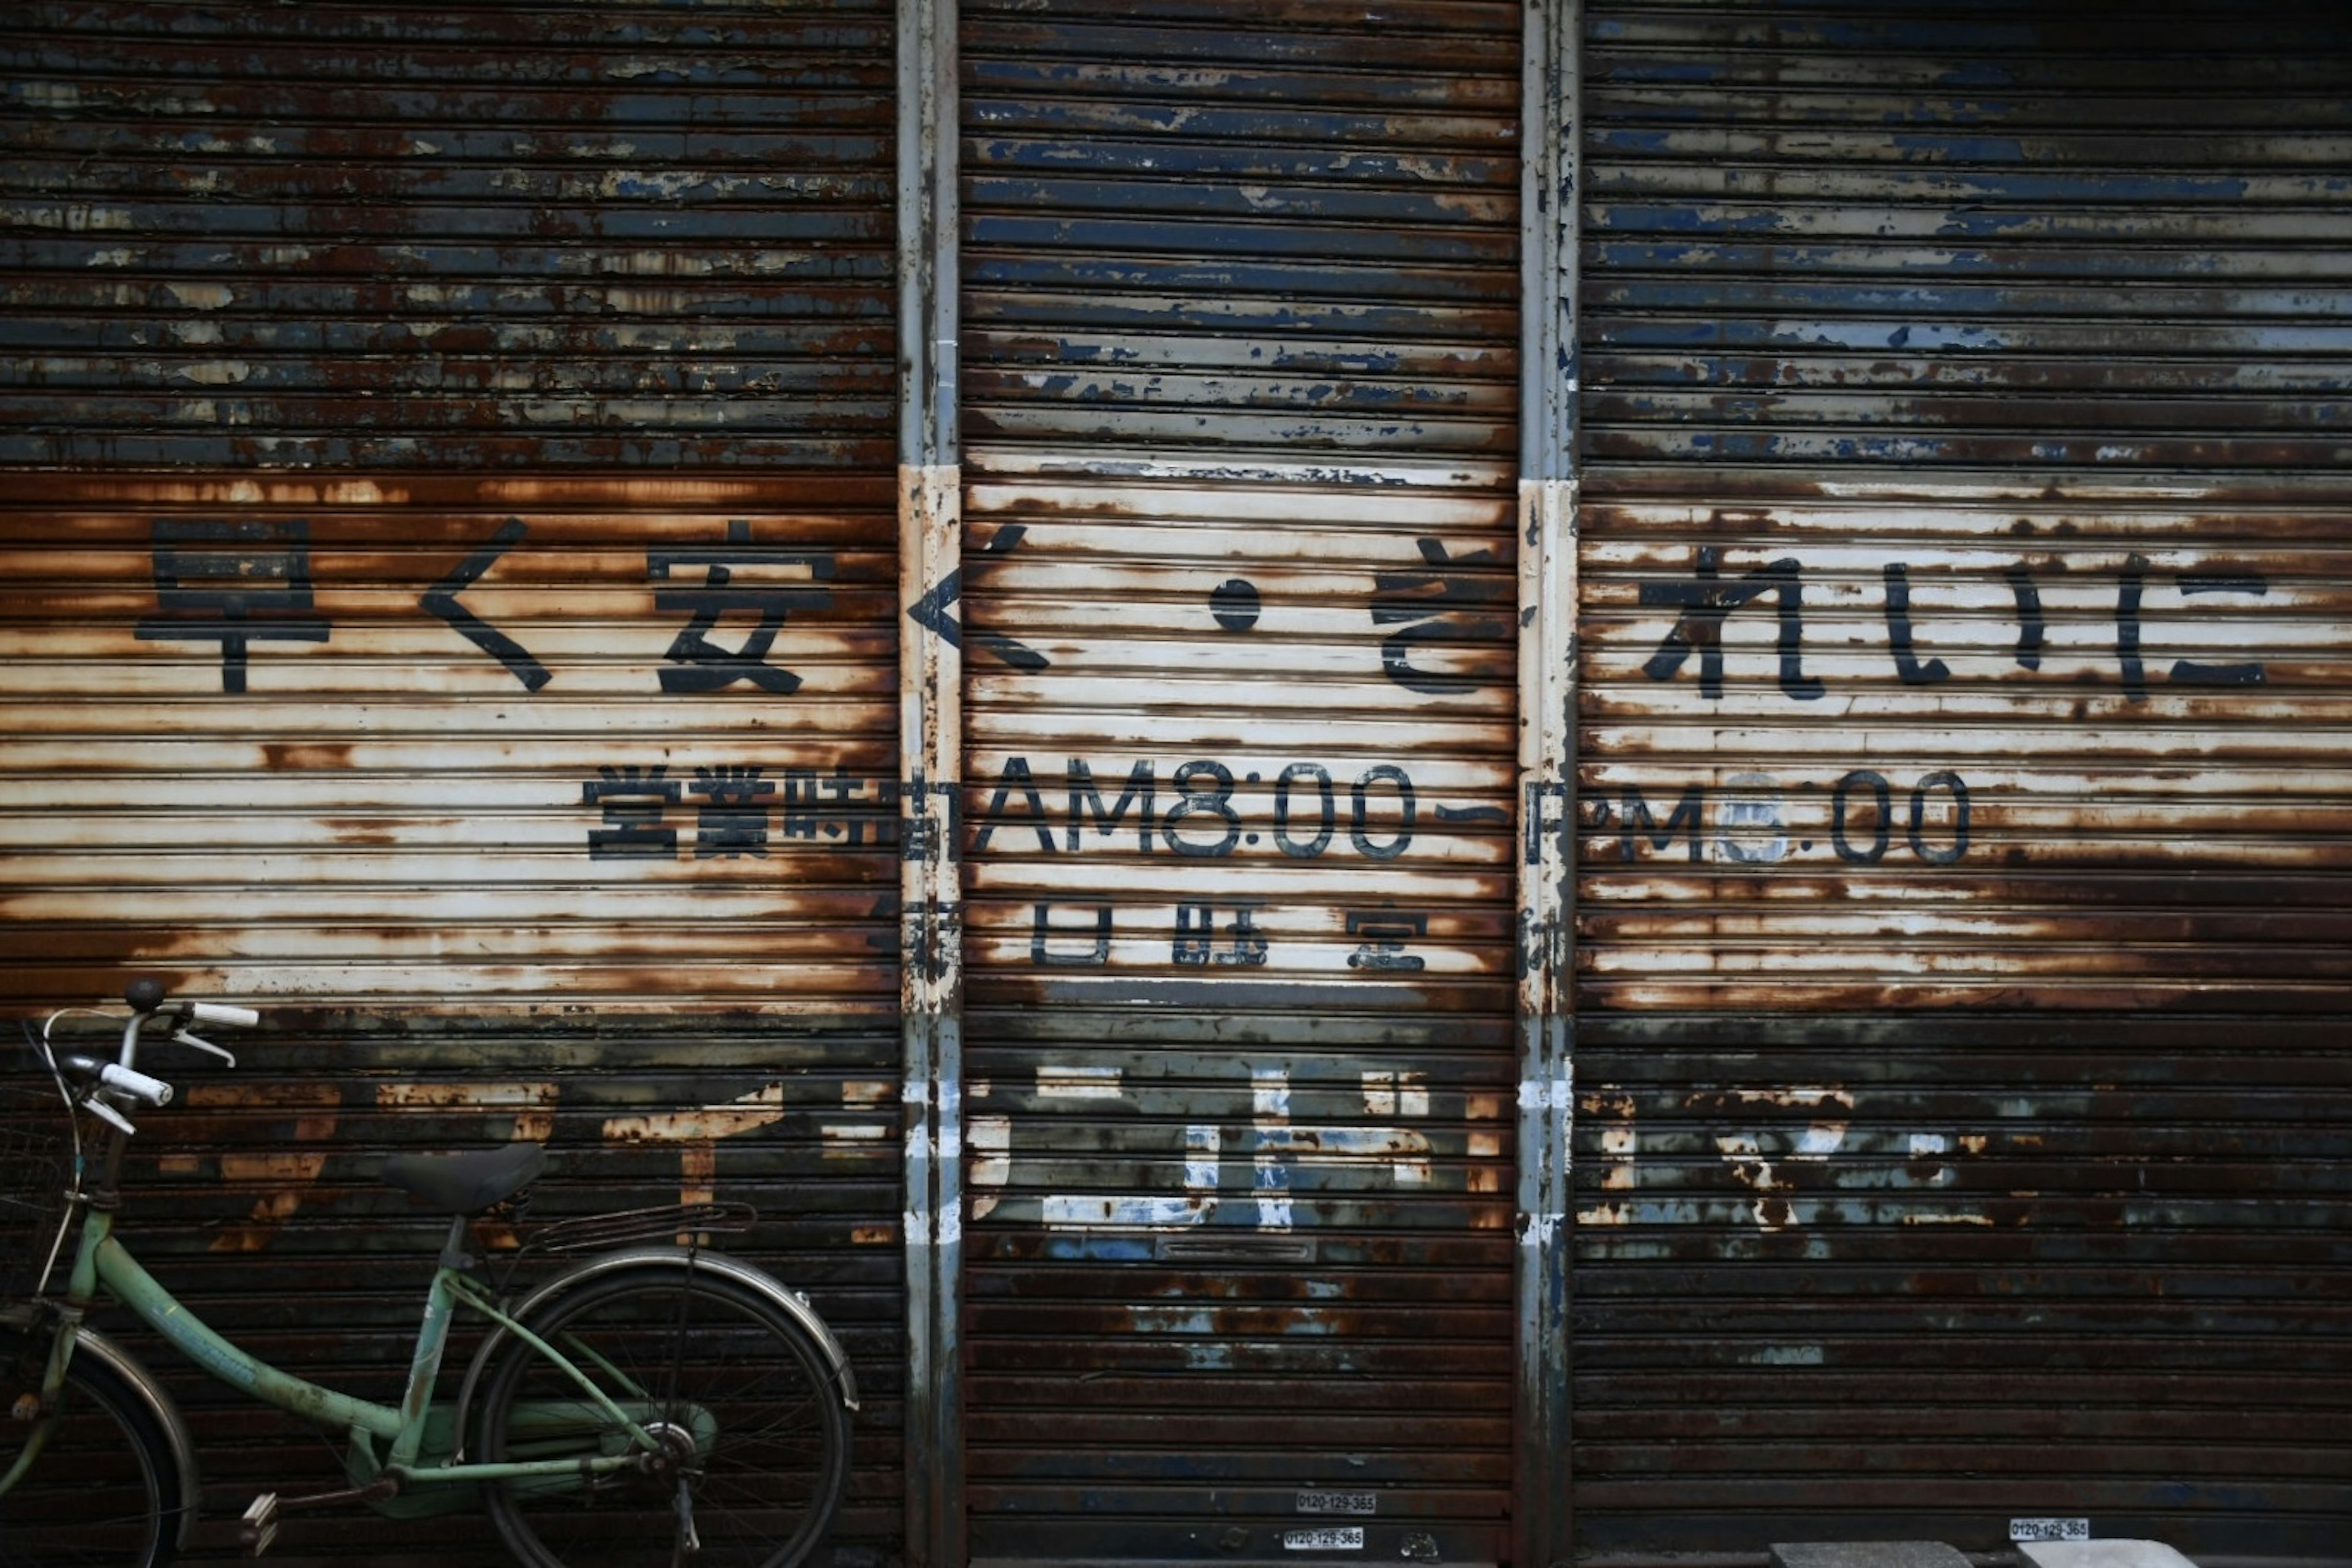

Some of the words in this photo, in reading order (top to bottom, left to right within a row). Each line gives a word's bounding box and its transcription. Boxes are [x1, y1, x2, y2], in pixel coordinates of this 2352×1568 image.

[1298, 1494, 1373, 1510] 0120-129-365
[2012, 1523, 2087, 1536] 0120-129-365
[1286, 1531, 1362, 1544] 0120-129-365
